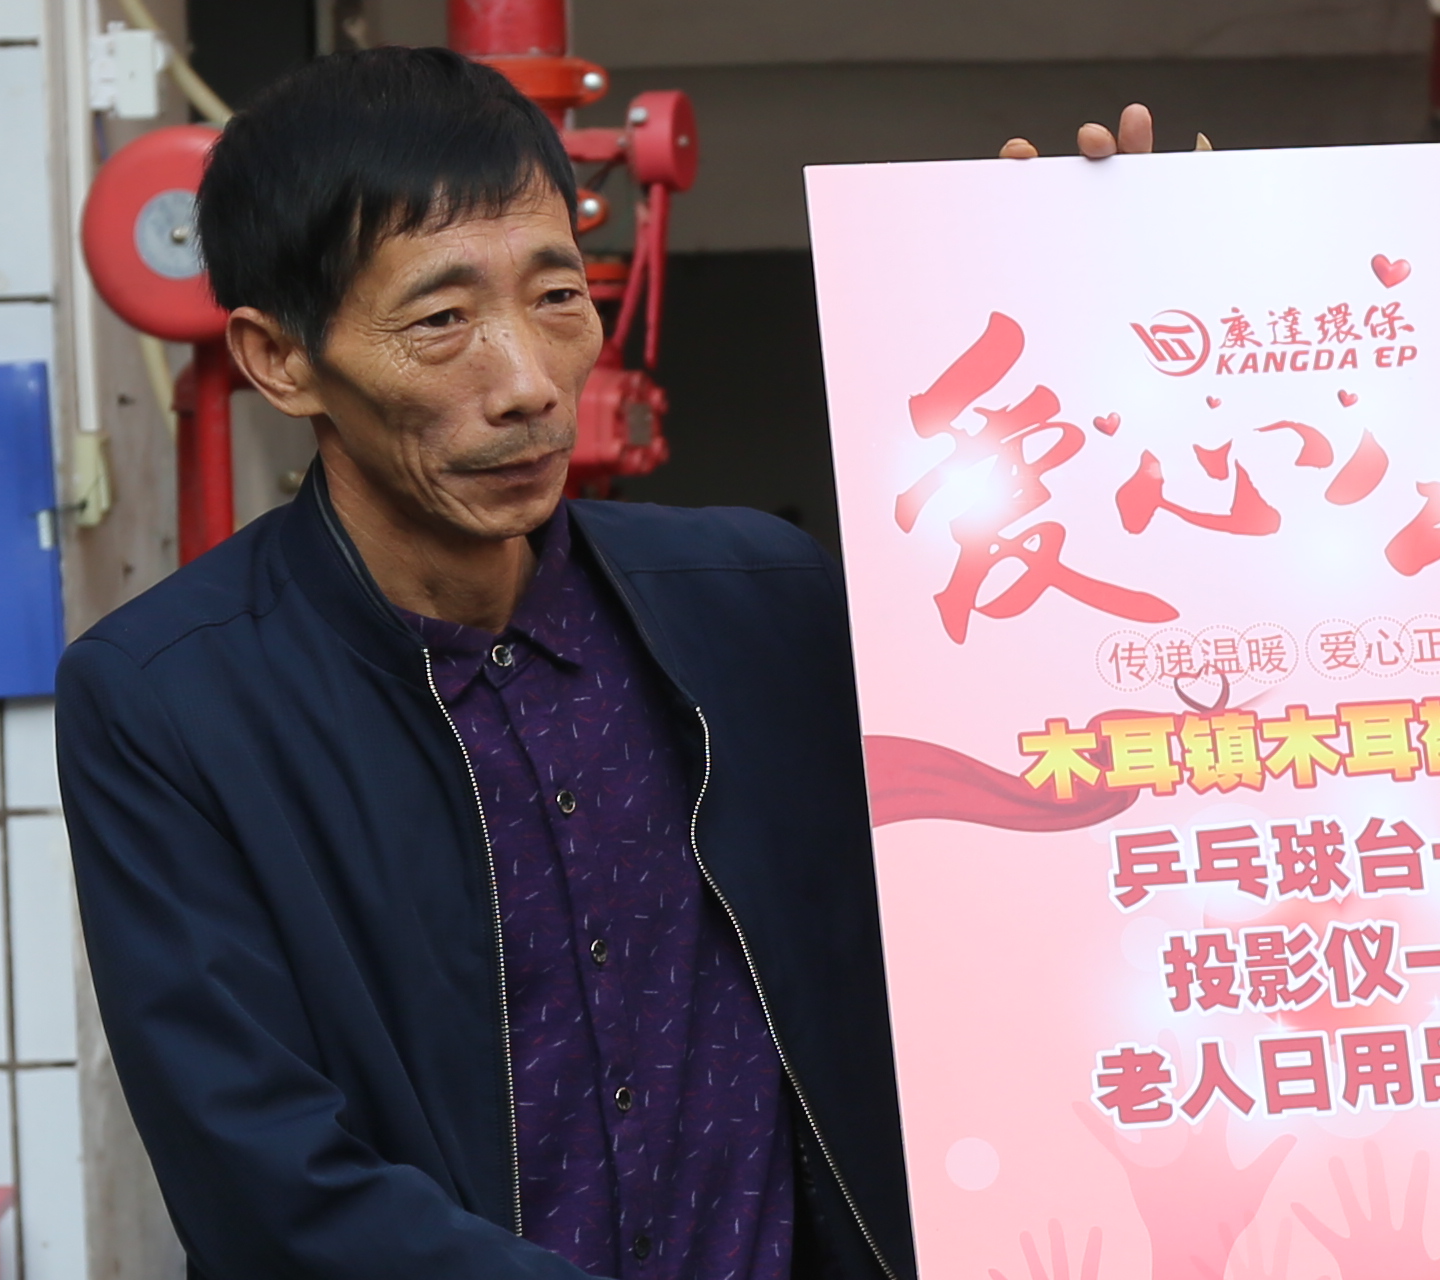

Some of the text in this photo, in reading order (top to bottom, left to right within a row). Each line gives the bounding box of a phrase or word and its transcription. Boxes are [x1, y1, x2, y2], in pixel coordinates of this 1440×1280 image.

[1216, 346, 1417, 375] KANGDA EP
[1108, 628, 1289, 685] 传递温暖
